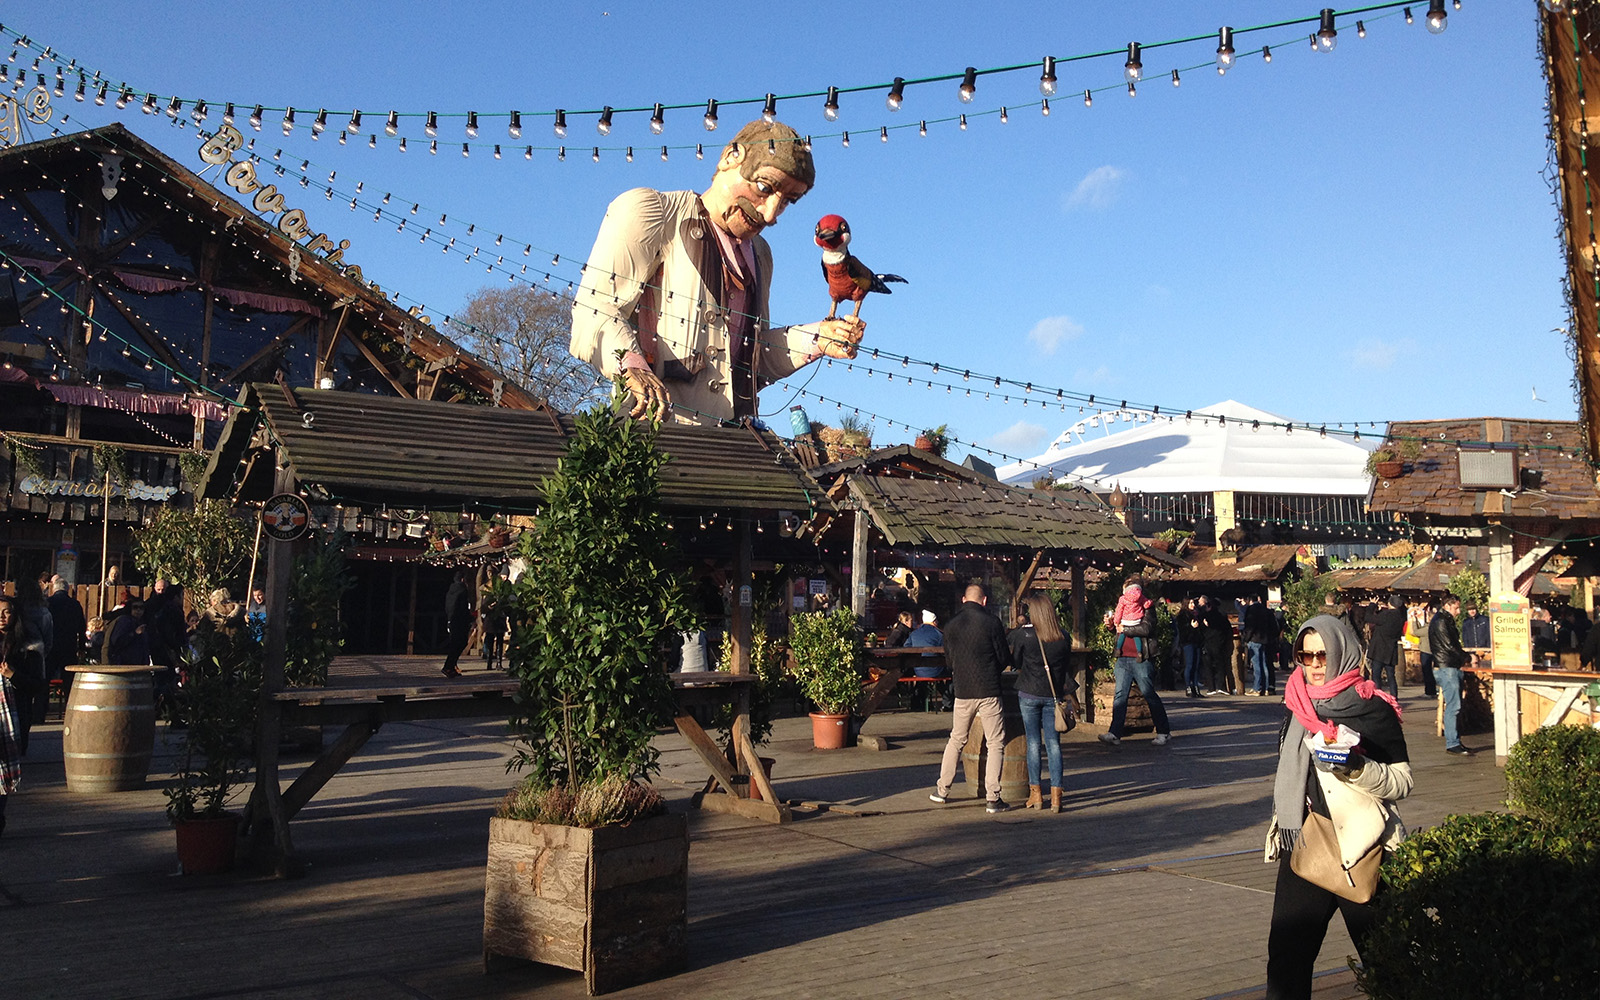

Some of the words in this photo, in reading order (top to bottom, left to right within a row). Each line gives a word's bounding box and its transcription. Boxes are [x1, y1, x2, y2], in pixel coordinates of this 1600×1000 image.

[269, 496, 304, 509] BAVARIAN
[273, 530, 294, 538] GOLD
[1495, 616, 1524, 624] Grilled
[1494, 625, 1527, 633] Salmon
[1318, 752, 1329, 760] Fish
[1333, 754, 1347, 762] Chips
